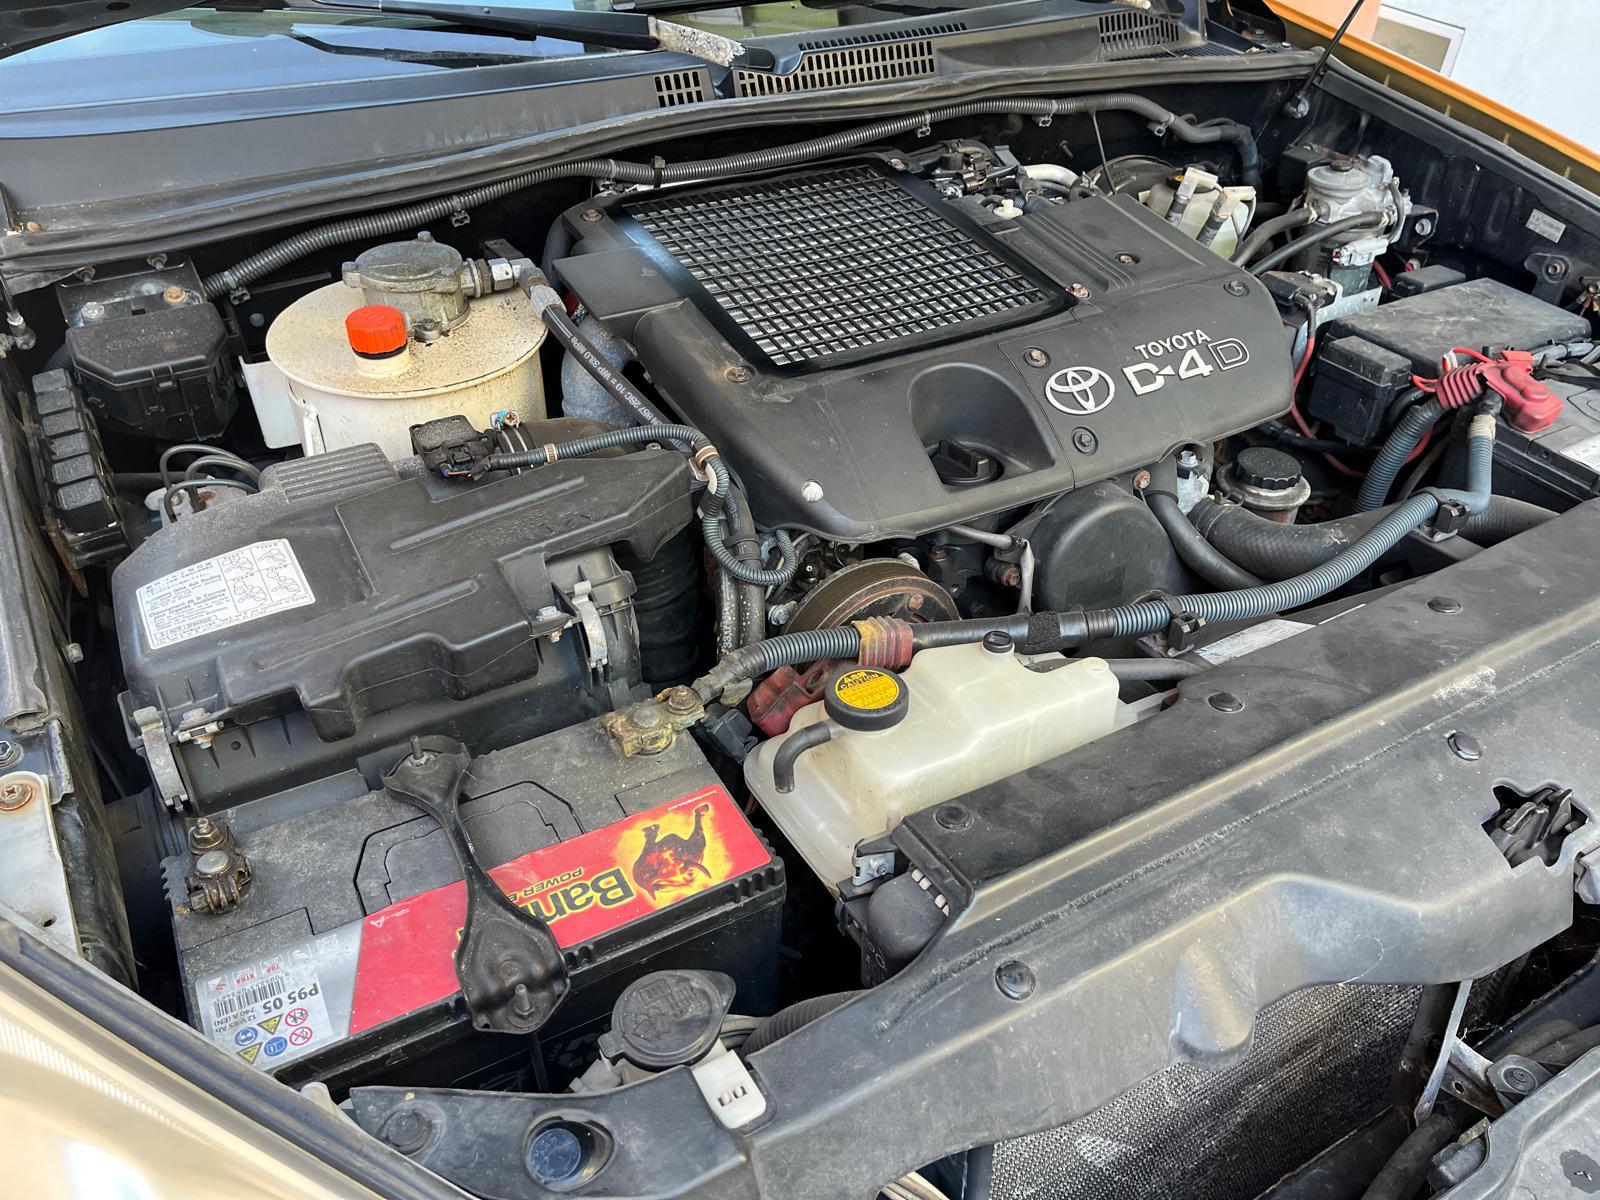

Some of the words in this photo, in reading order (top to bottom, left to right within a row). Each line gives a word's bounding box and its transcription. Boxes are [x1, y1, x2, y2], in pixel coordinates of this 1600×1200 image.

[570, 336, 587, 354] MPa
[1134, 329, 1211, 359] TOYOTA
[584, 351, 600, 368] 33.0
[597, 365, 612, 380] WP
[615, 383, 625, 393] 10
[625, 392, 641, 408] 2SC
[640, 406, 654, 420] 857
[840, 673, 879, 689] CAUTION
[524, 868, 583, 896] POWER
[526, 867, 635, 923] Ban
[287, 983, 319, 1005] P95
[240, 1007, 256, 1017] 740
[262, 997, 283, 1014] 05
